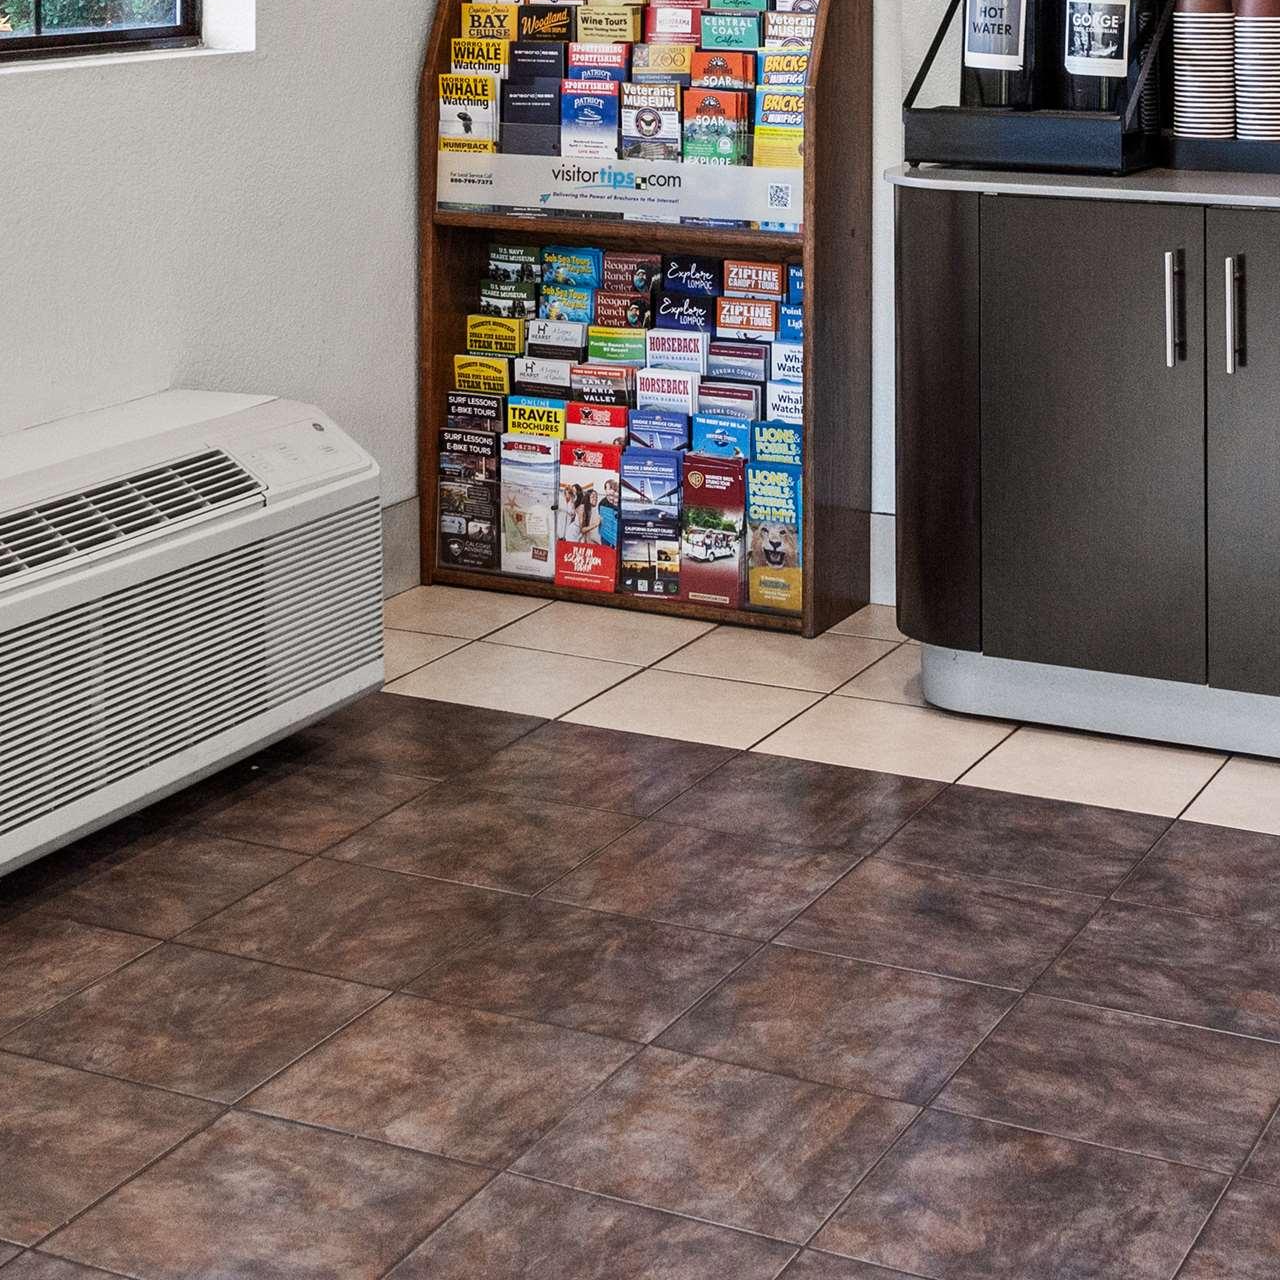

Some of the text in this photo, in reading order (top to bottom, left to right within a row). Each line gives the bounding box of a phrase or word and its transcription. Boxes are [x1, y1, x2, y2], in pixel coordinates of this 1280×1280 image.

[980, 7, 1004, 20] HOT
[470, 15, 508, 28] BAY
[522, 11, 569, 34] Woodland
[581, 16, 627, 26] Wine Tours
[704, 17, 752, 27] CENTRAL
[469, 29, 510, 39] CRUISE
[712, 26, 745, 35] COAST
[973, 23, 1012, 36] WATER
[453, 48, 501, 60] WHALE
[572, 54, 621, 62] SPORTFISHING
[453, 60, 501, 73] Watching
[765, 55, 807, 72] BRICKS
[565, 82, 614, 90] SPORTFISHING
[703, 76, 731, 86] SOAR
[442, 84, 488, 97] WHALE
[622, 85, 675, 95] Veterans
[442, 96, 489, 109] Watching
[574, 97, 604, 108] PATRIOT
[624, 96, 675, 107] MUSEUM
[763, 94, 804, 112] BRICKS
[696, 116, 724, 126] SOAR
[443, 141, 488, 149] HUMPBACK
[604, 260, 637, 270] Reagan
[604, 271, 631, 281] Ranch
[668, 262, 713, 283] Explore
[730, 269, 778, 282] ZIPLINE
[604, 282, 633, 291] Center
[688, 280, 712, 290] LOMPOC
[728, 279, 779, 290] CANOPY TOURS
[598, 295, 630, 307] Reagan
[598, 307, 625, 316] Ranch
[660, 298, 706, 319] Explore
[722, 305, 771, 318] ZIPLINE
[598, 318, 626, 327] Center
[680, 315, 705, 326] LOMPOC
[720, 315, 772, 326] CANOPY TOURS
[469, 340, 516, 351] STEAM TRAIN
[649, 336, 700, 353] HORSEBACK
[458, 380, 504, 392] STEAM TRAIN
[640, 377, 689, 394] HORSEBACK
[448, 396, 498, 407] SURF LESSONS
[451, 406, 496, 416] E-BIKE TOURS
[511, 408, 560, 423] TRAVEL
[511, 422, 559, 432] BROCHURES
[444, 432, 494, 445] SURF LESSONS
[446, 443, 491, 455] E-BIKE TOURS
